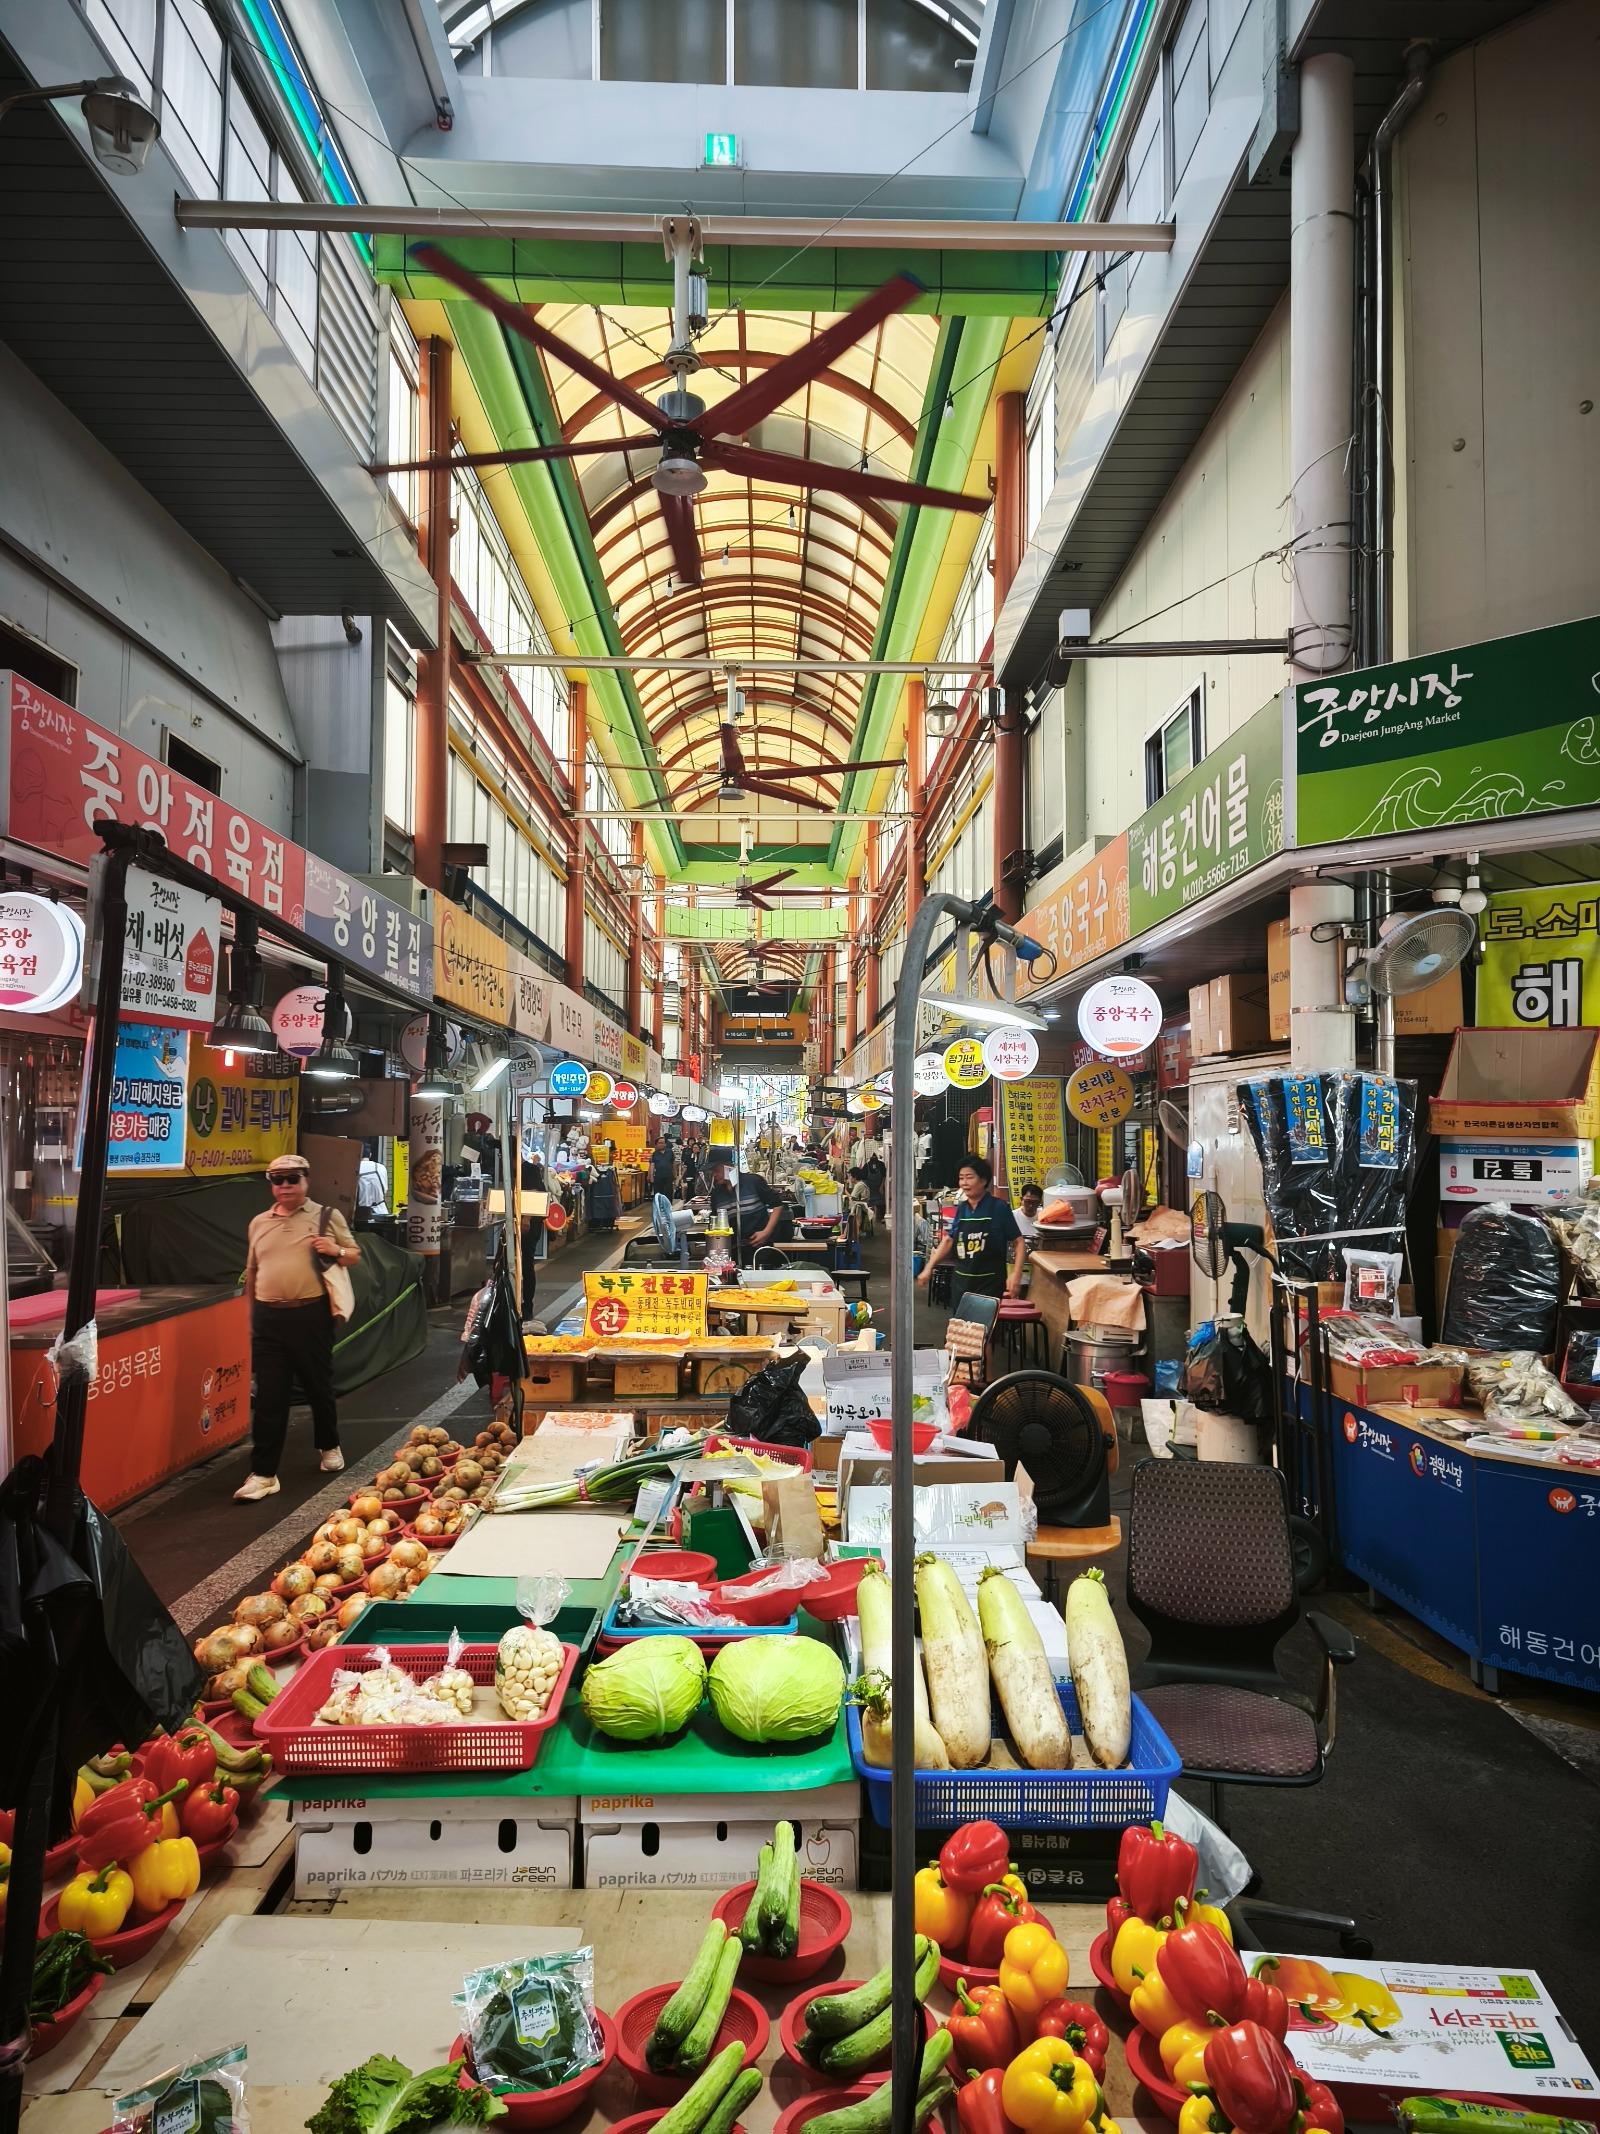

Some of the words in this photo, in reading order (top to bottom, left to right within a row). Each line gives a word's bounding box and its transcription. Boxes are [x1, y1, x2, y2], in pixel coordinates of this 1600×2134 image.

[1298, 663, 1474, 747] 중앙시장
[1341, 728, 1379, 743] Daejeon
[1380, 720, 1423, 738] JungAng
[1425, 711, 1461, 727] Market
[80, 728, 284, 915] 중앙정육점
[1142, 753, 1253, 898] 해동건어물
[333, 878, 421, 977] 중앙칼집
[1093, 1006, 1154, 1022] 중앙국수
[130, 1081, 183, 1106] 피해지원금
[1077, 1069, 1116, 1094] 보리밥
[1079, 1085, 1129, 1114] 잔치국수
[1291, 1085, 1303, 1117] 자연산
[1367, 1089, 1379, 1121] 자연산
[1098, 1107, 1121, 1123] 전문
[598, 1275, 635, 1294] 녹두
[641, 1275, 695, 1295] 전문점
[593, 1302, 620, 1332] 전
[1358, 1420, 1392, 1453] 중앙시장
[1579, 1494, 1600, 1517] 중
[302, 1798, 367, 1812] paprika
[591, 1796, 654, 1812] paprika
[307, 1868, 367, 1884] paprika
[371, 1869, 407, 1881] パプリカ
[460, 1867, 507, 1882] 파프리카
[599, 1872, 657, 1888] paprika
[1429, 2007, 1539, 2030] 파프리카
